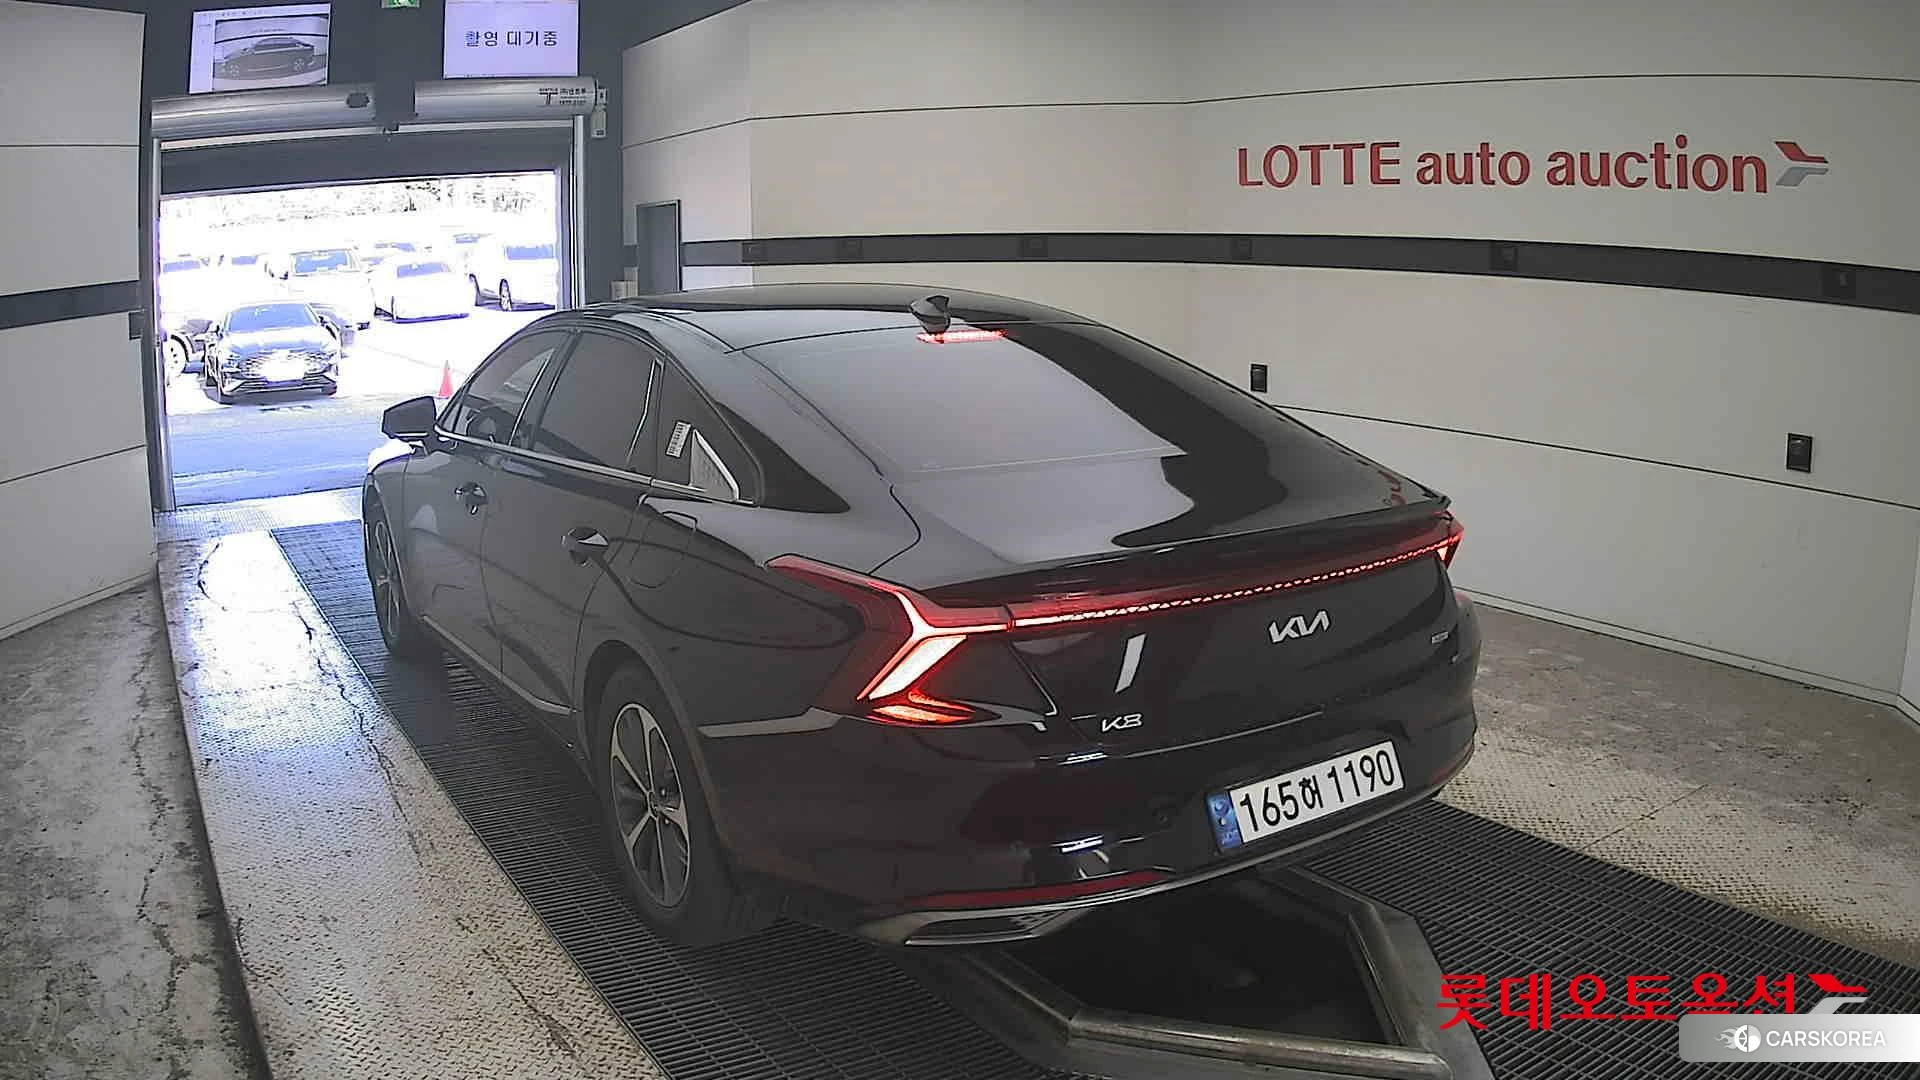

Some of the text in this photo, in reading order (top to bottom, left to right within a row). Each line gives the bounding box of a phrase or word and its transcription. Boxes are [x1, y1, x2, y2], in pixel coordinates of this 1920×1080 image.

[1238, 134, 1768, 193] LOTTE auto auction
[1268, 610, 1330, 643] KIA
[1101, 713, 1143, 732] K8
[1239, 750, 1395, 832] 165허 1190
